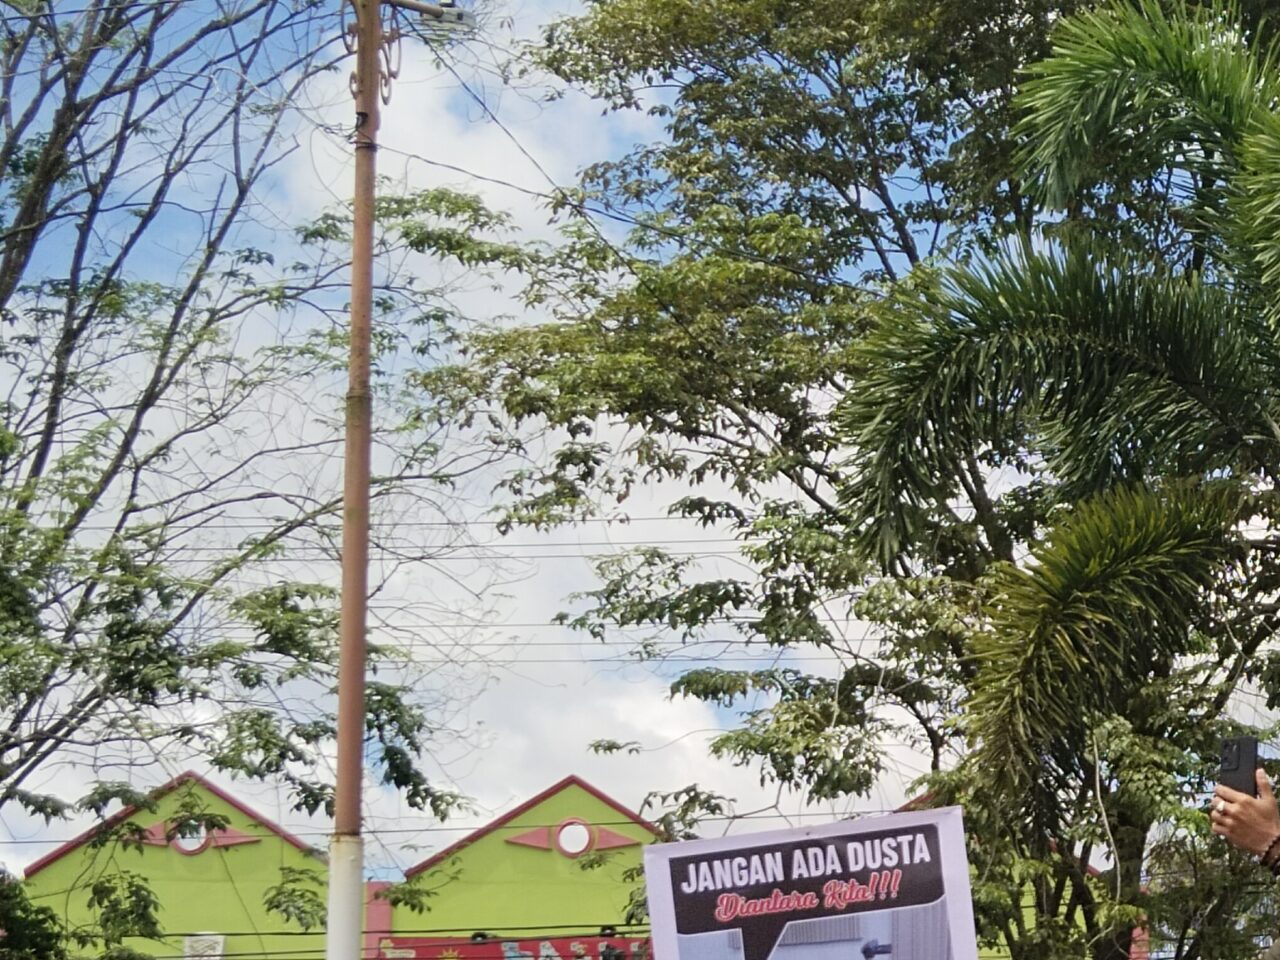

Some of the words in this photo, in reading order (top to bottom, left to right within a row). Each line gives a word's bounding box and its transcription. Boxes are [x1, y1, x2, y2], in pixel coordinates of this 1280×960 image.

[681, 851, 784, 893] JANGAN
[792, 844, 842, 879] ADA
[847, 833, 931, 873] DUSTA
[715, 888, 820, 922] Diantara
